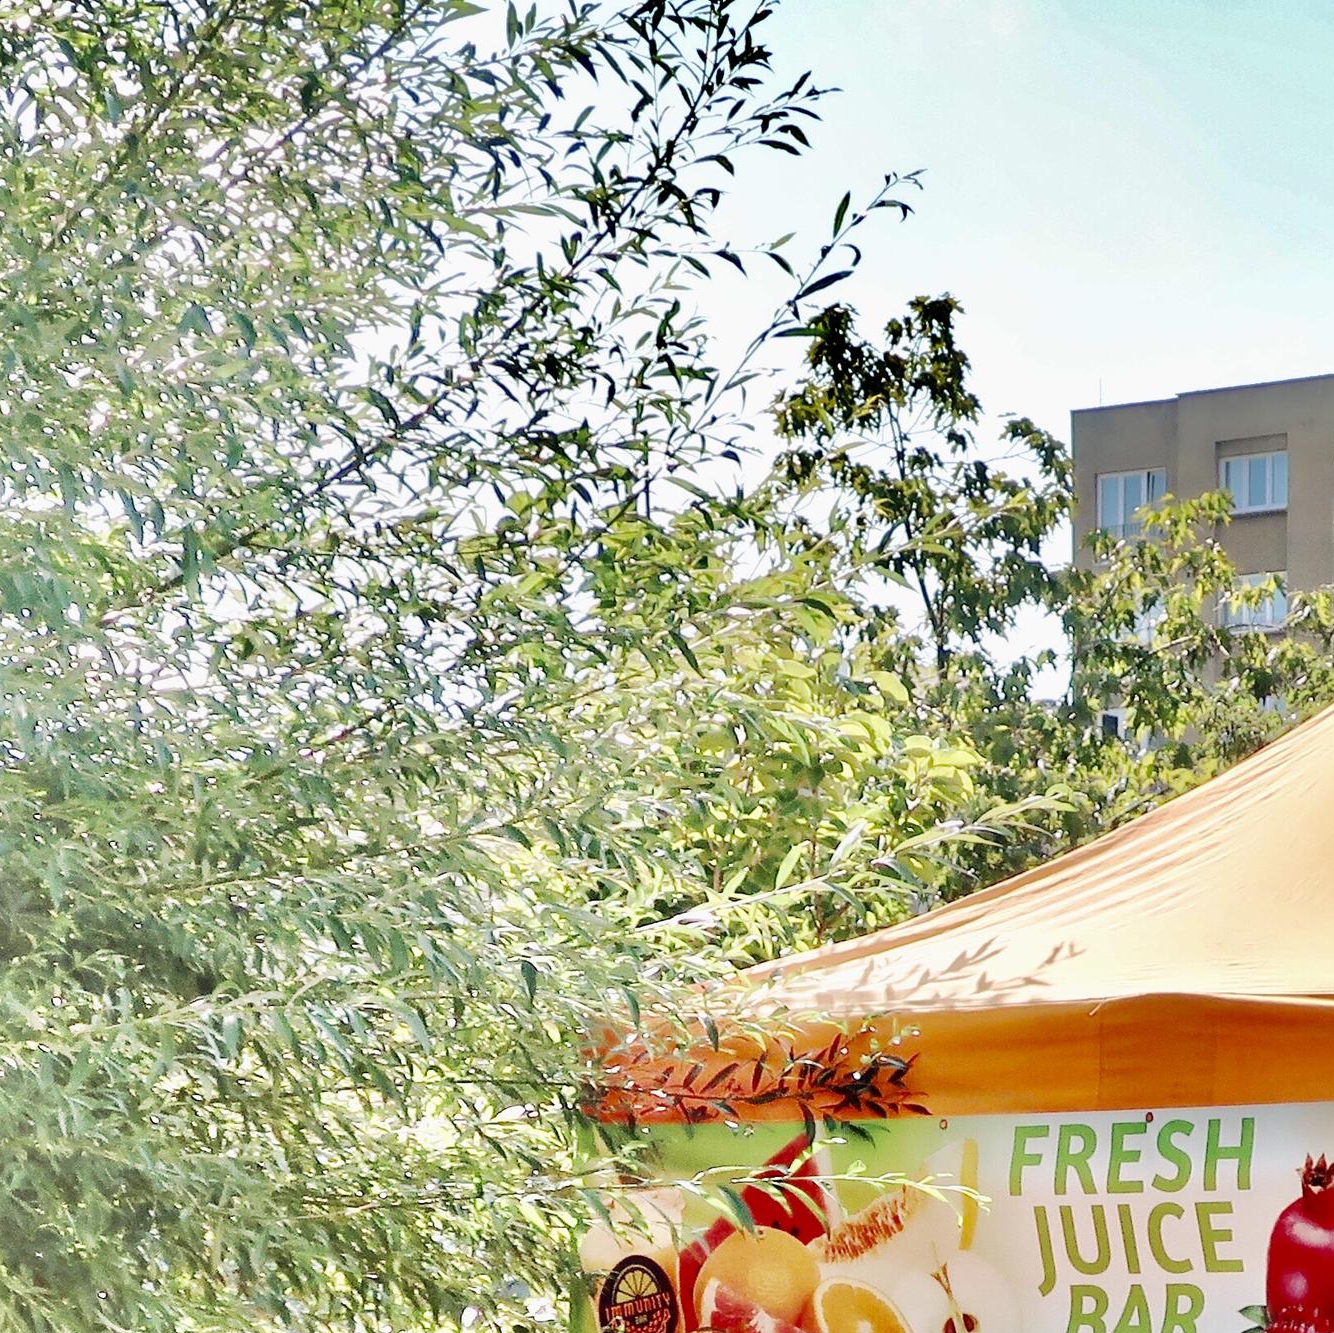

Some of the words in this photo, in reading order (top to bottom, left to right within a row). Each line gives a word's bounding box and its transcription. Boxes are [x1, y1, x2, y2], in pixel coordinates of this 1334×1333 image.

[1009, 1117, 1255, 1196] FRESH
[1033, 1201, 1244, 1297] JUICE
[605, 1292, 670, 1322] IMMUNITY
